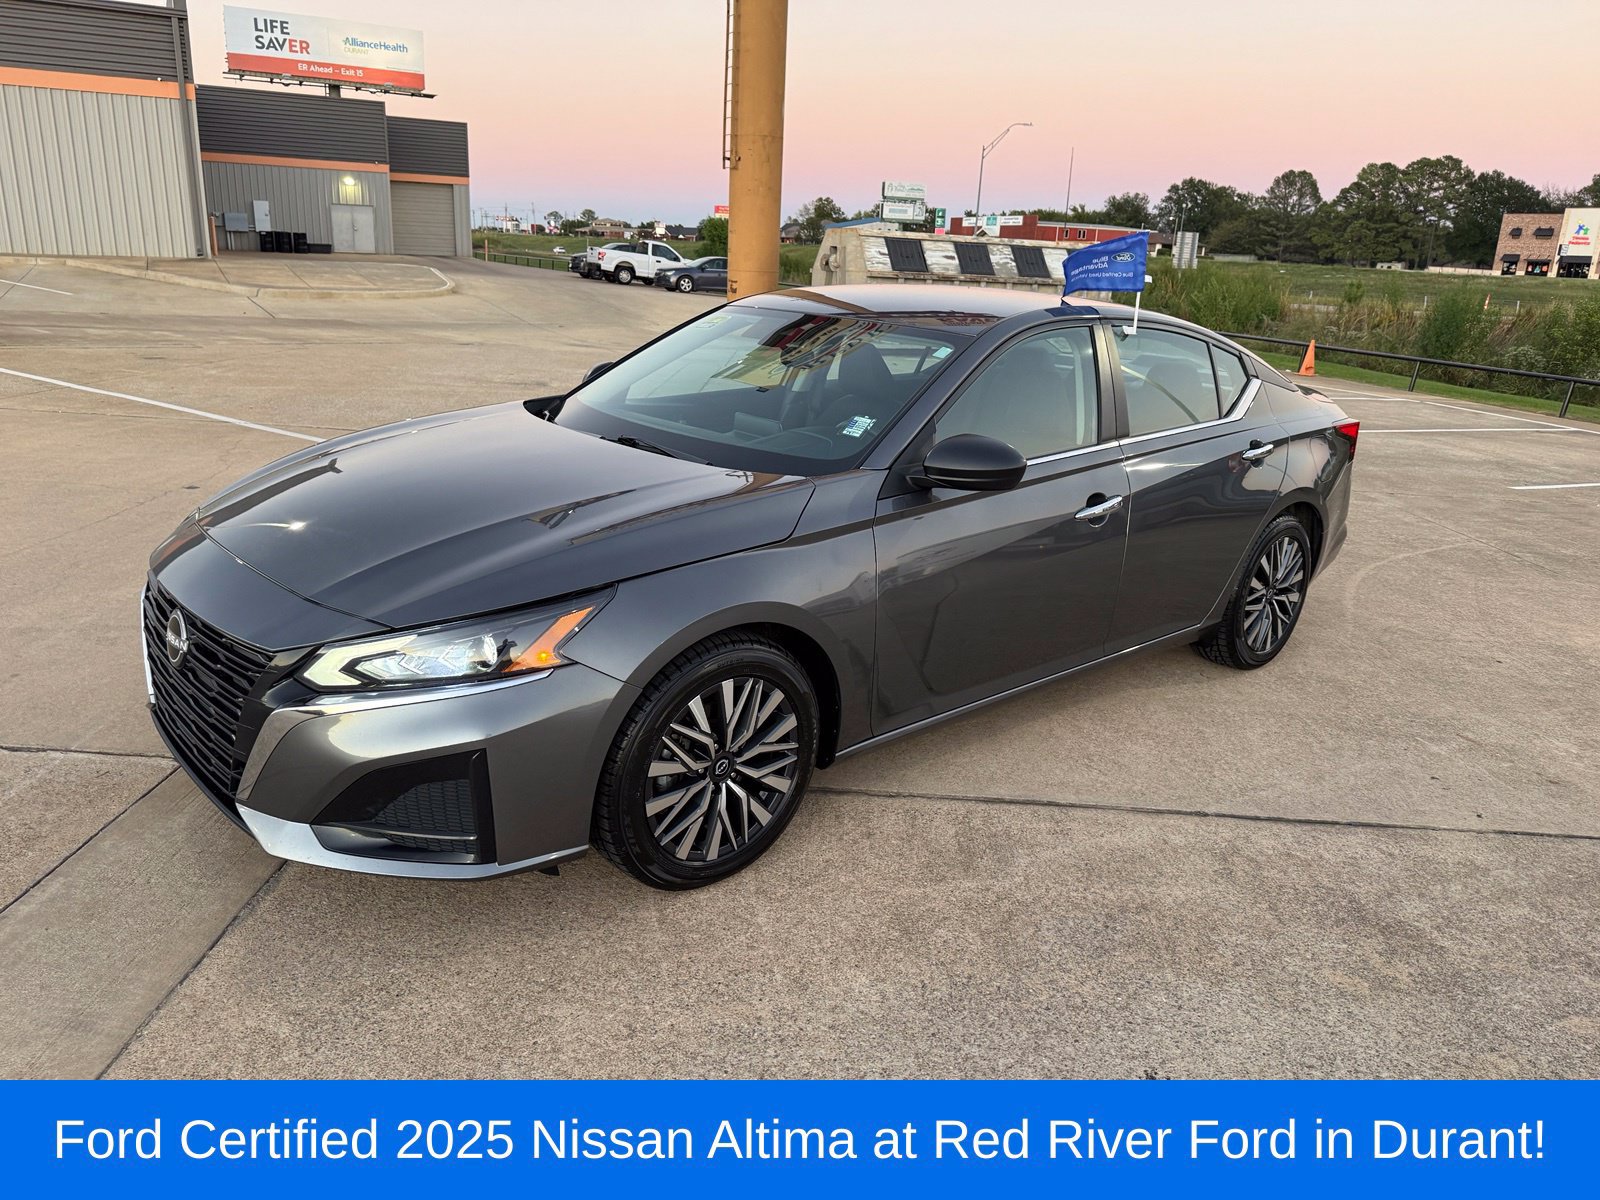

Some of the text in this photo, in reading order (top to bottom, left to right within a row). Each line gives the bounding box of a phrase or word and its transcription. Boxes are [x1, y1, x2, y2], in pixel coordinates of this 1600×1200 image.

[253, 17, 290, 35] LIFE
[255, 35, 310, 55] SAVER
[343, 37, 408, 53] AllianceHealth
[298, 63, 308, 71] ER
[310, 64, 333, 74] Ahead
[341, 68, 356, 76] Exit
[356, 69, 364, 77] 15
